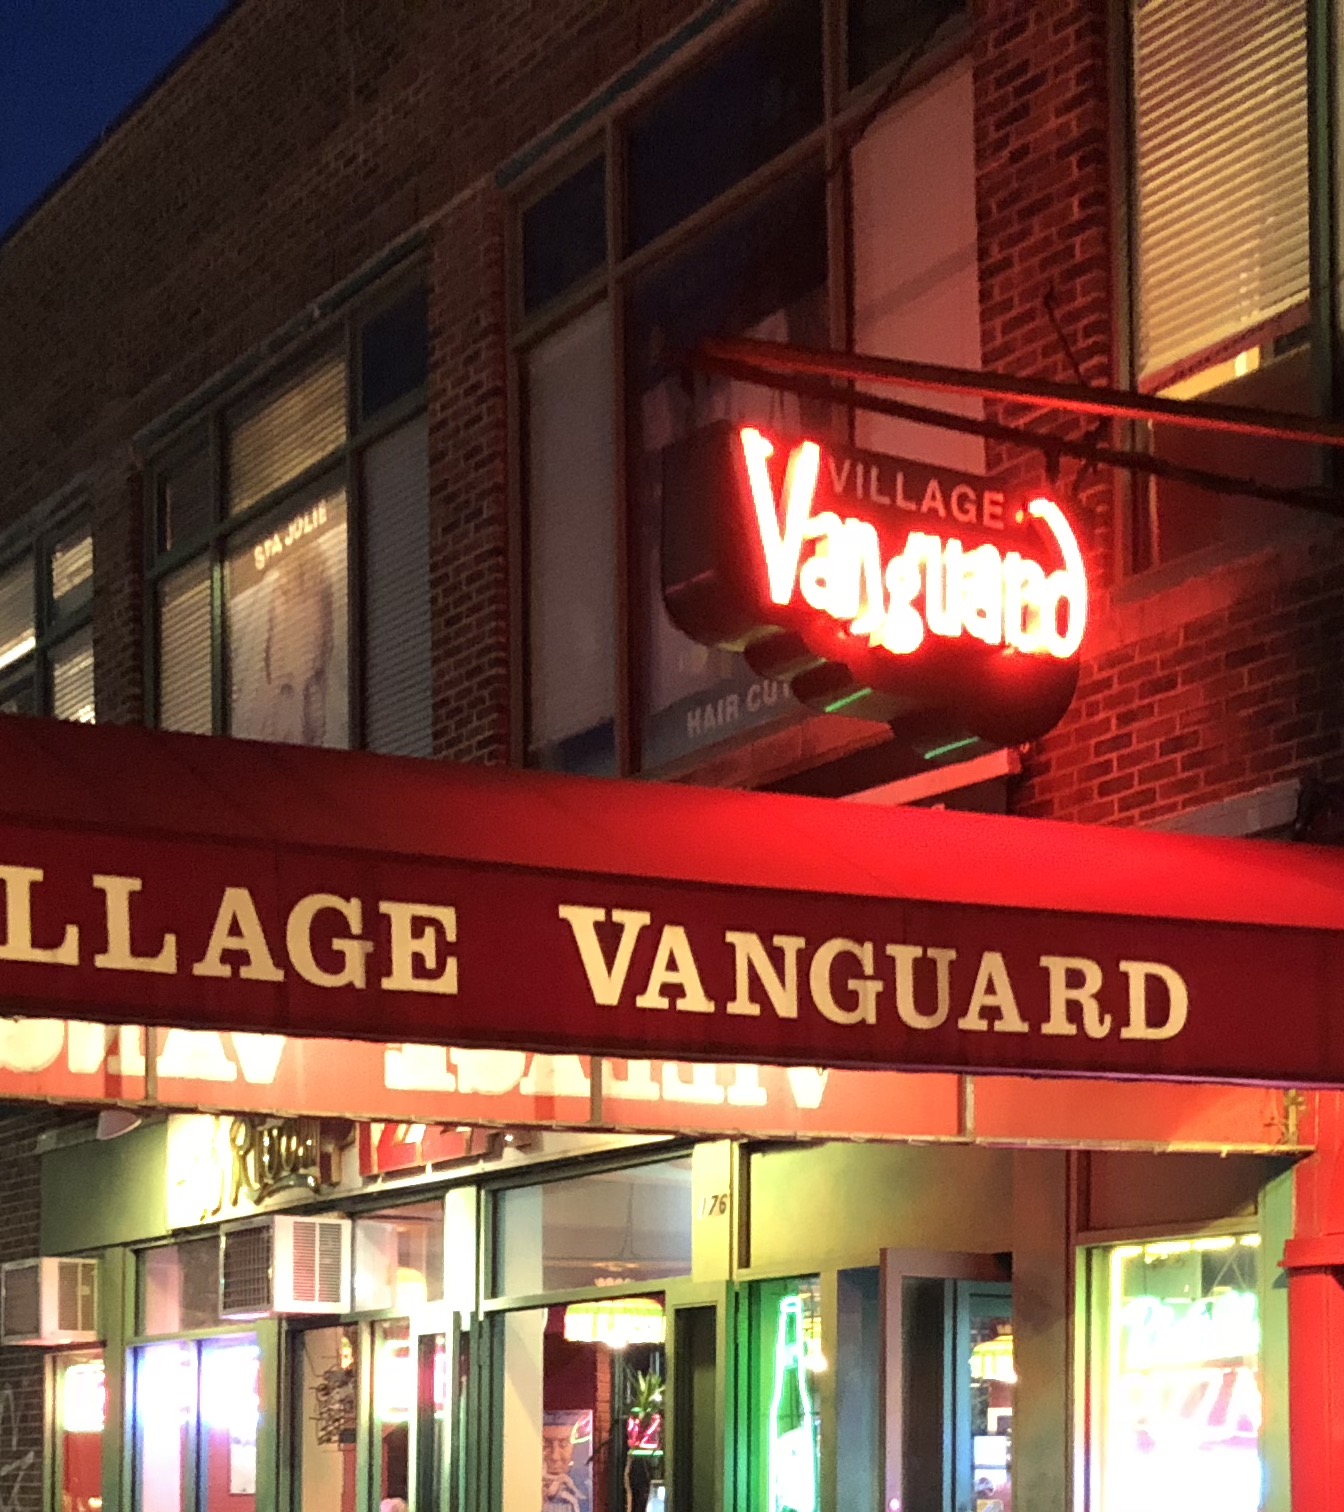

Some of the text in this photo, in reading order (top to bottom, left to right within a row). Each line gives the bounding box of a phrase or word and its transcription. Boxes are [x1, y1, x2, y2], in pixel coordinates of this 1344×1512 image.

[740, 426, 1088, 659] Vanguard
[829, 457, 1006, 530] VILLAGE
[686, 694, 740, 738] HAIR
[558, 904, 1190, 1040] VANGUARD
